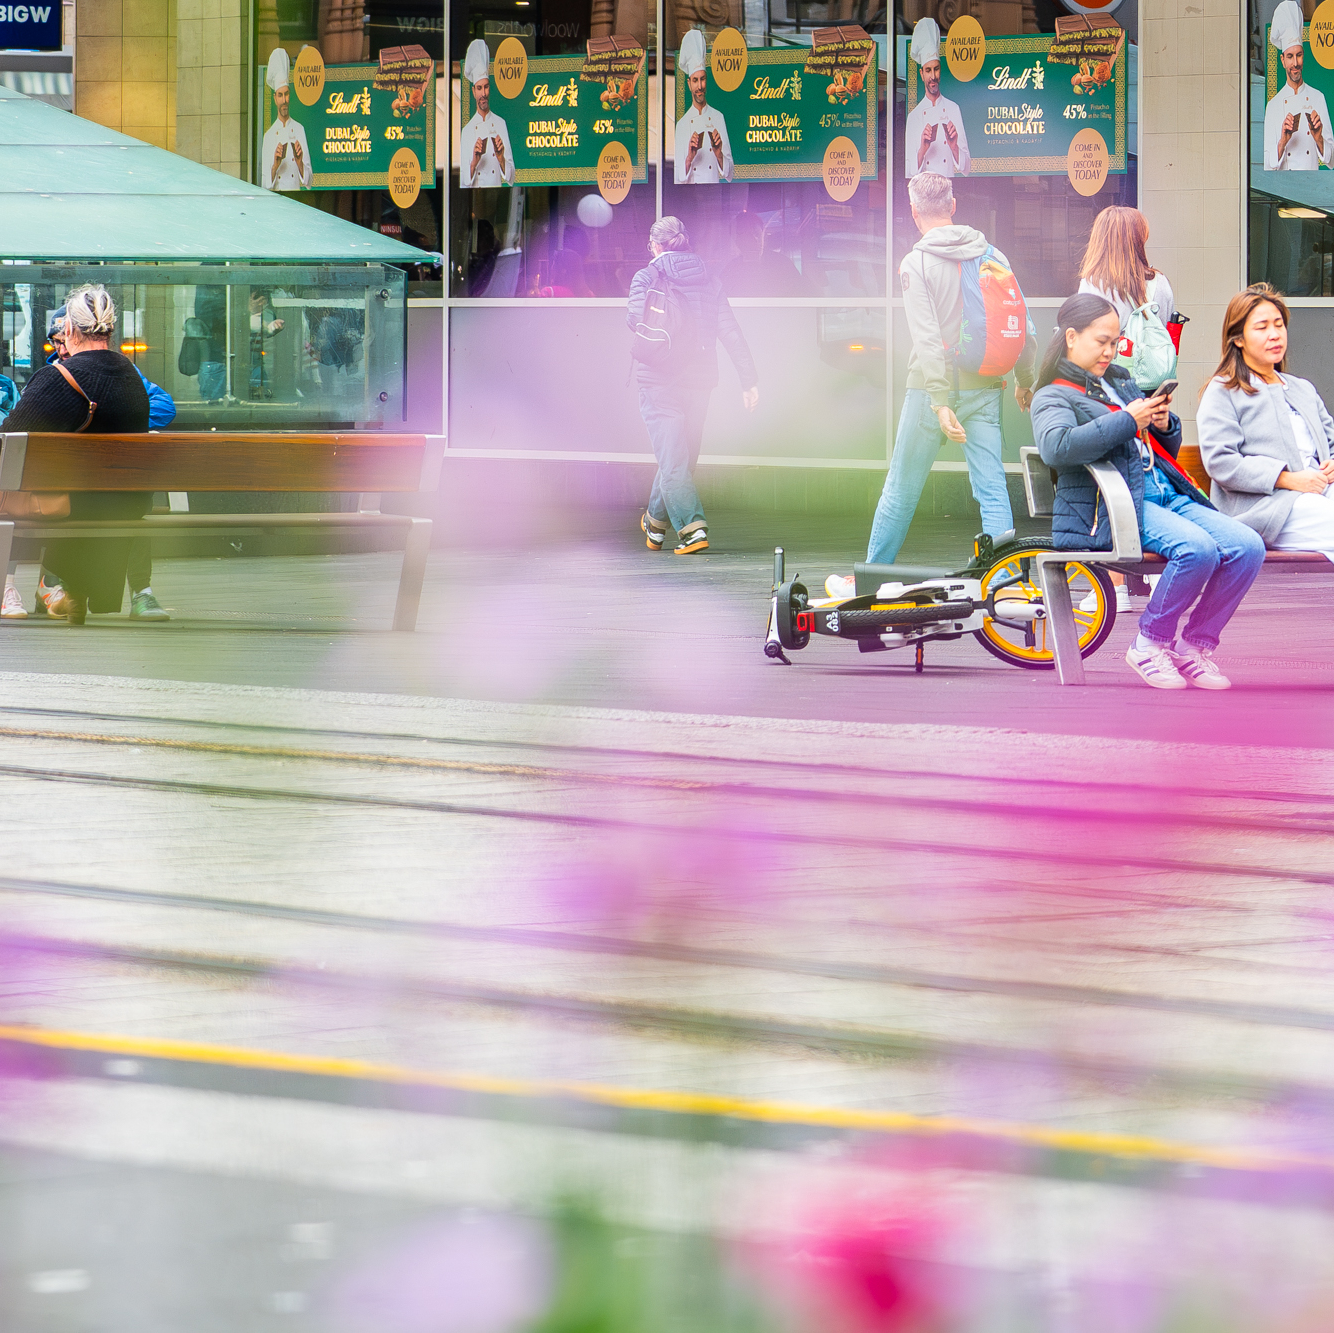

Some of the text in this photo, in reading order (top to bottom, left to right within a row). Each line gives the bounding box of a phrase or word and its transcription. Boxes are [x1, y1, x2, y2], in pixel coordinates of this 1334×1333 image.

[950, 36, 981, 45] AVAILABLE
[715, 48, 743, 56] AVAILABLE
[951, 47, 980, 62] NOW
[716, 58, 743, 72] NOW
[499, 67, 523, 80] NOW
[988, 66, 1032, 90] Lindt
[750, 76, 790, 99] Lindt
[529, 84, 567, 107] Lindt
[988, 103, 1043, 125] DUBAI Style
[1063, 104, 1087, 119] 45%
[593, 120, 614, 134] 45%
[749, 112, 800, 133] DUBAI Style
[819, 113, 840, 128] 45%
[529, 118, 577, 138] DUBAI Style
[984, 121, 1046, 135] CHOCOLATE
[526, 135, 578, 148] CHOCOLATE
[746, 129, 802, 143] CHOCOLATE
[1093, 143, 1100, 151] IN
[829, 151, 853, 159] COME IN
[828, 167, 855, 175] DISCOVER
[1073, 160, 1102, 168] DISCOVER
[602, 171, 627, 179] DISCOVER
[829, 176, 854, 187] TODAY
[1074, 169, 1101, 180] TODAY
[603, 180, 627, 189] TODAY
